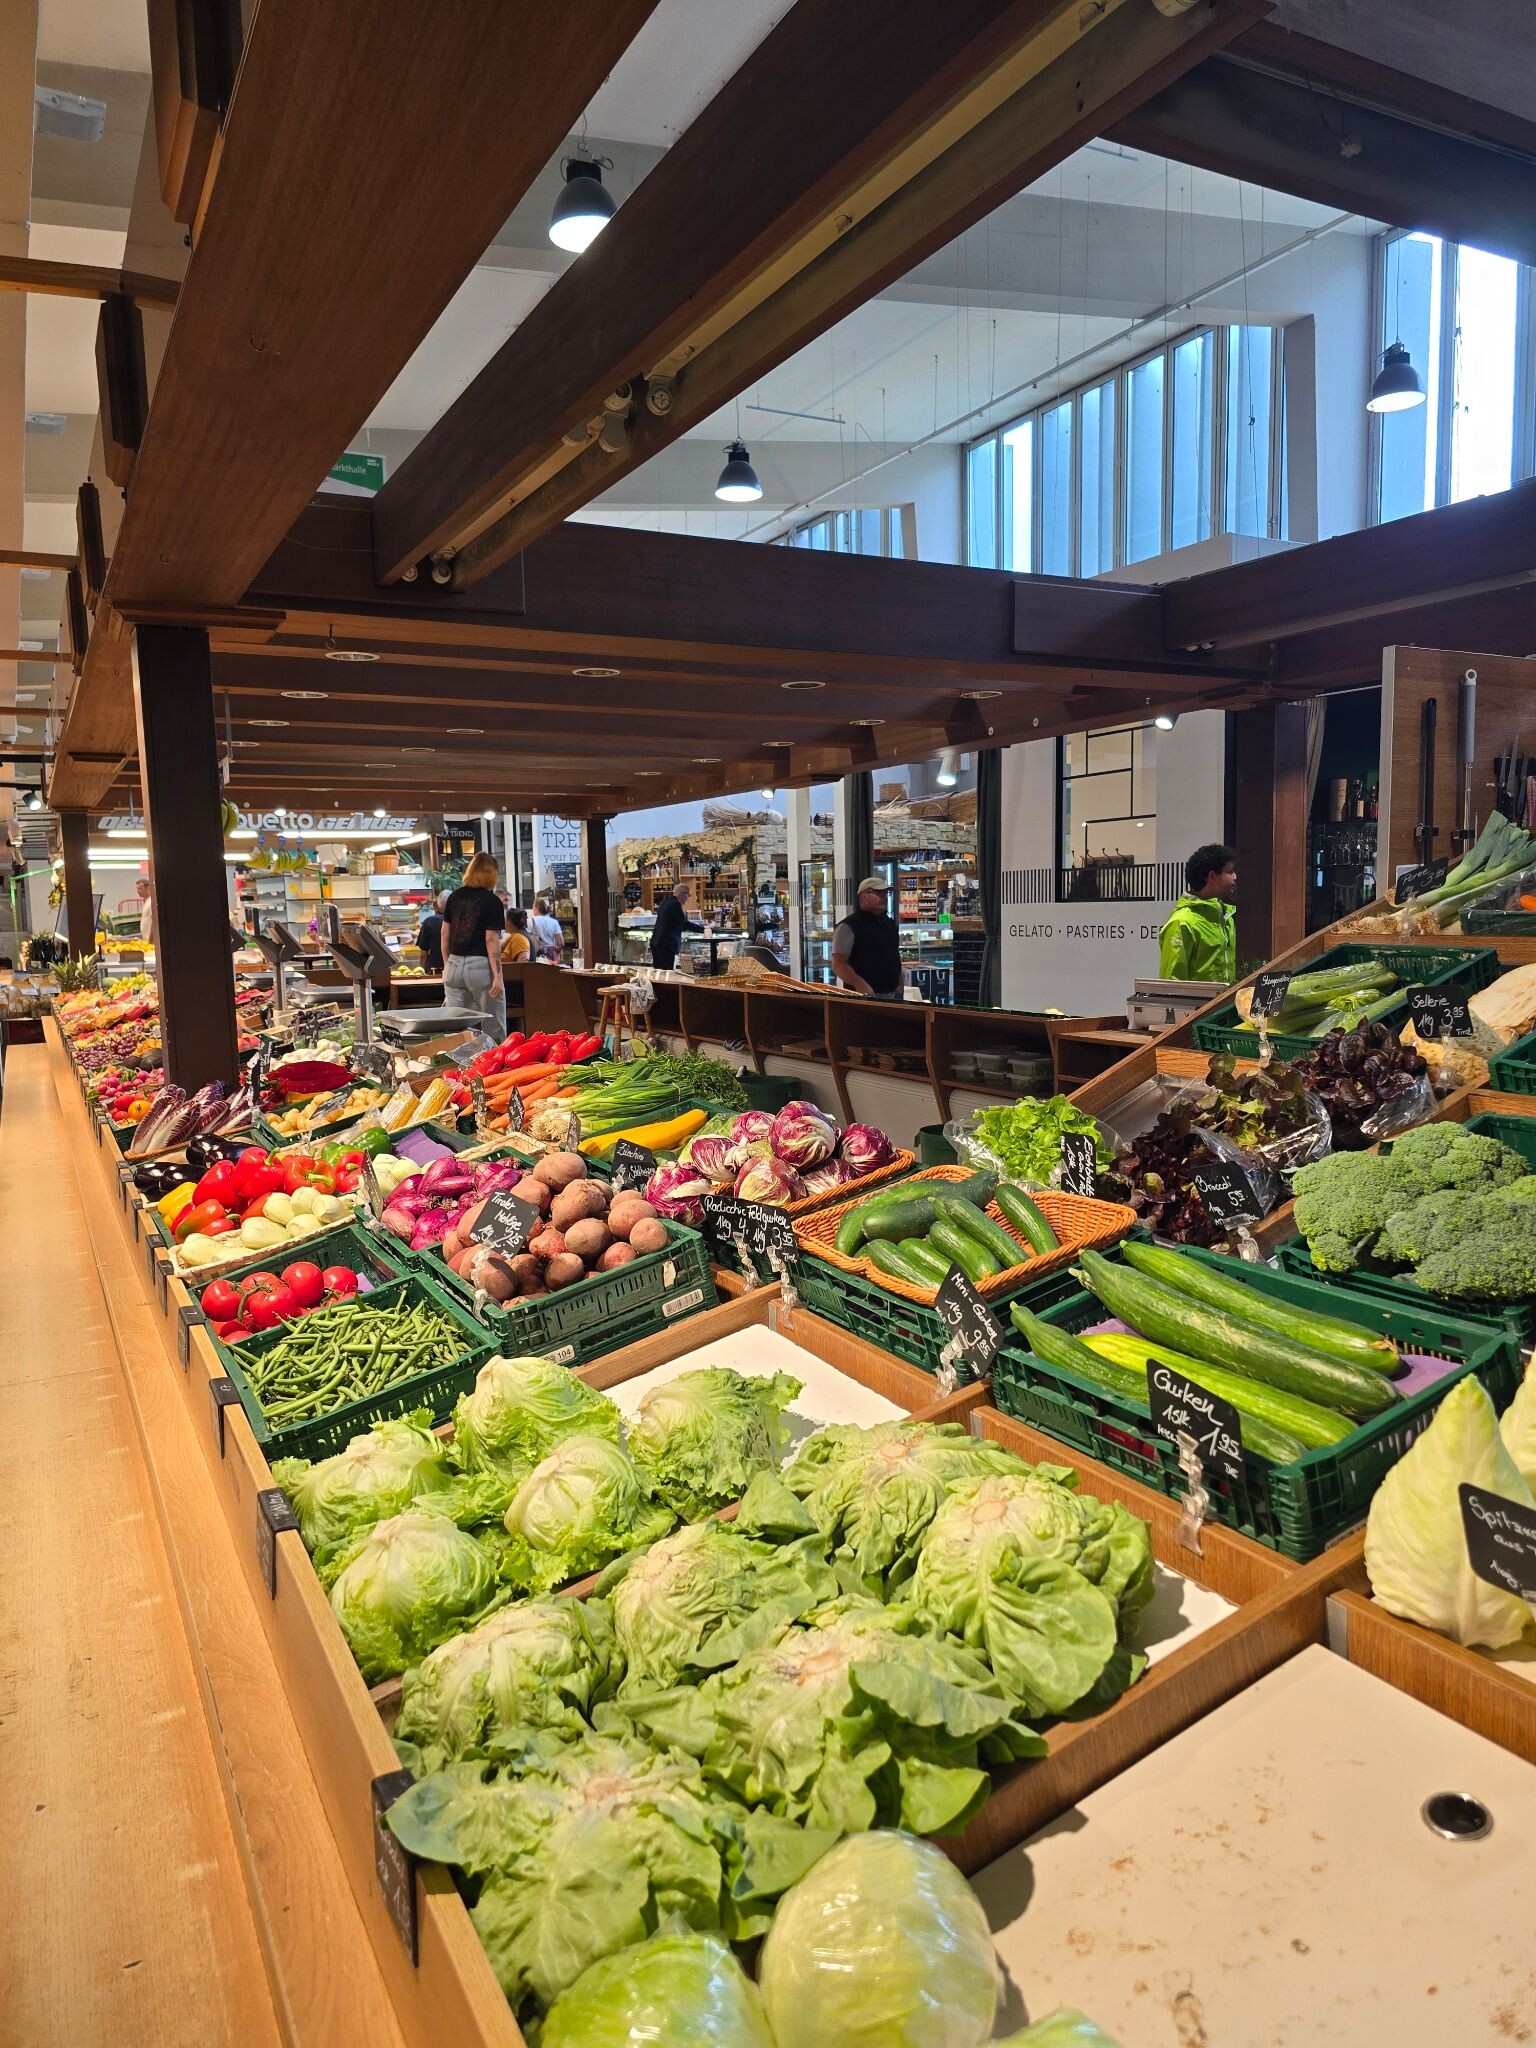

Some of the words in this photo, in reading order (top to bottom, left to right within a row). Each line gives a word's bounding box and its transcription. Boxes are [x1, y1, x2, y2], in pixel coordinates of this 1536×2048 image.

[332, 463, 367, 475] arkthalle
[542, 832, 581, 848] TRE
[1009, 924, 1053, 938] GELATO
[1066, 925, 1125, 939] PASTRIES
[1411, 993, 1450, 1009] Sellerie
[1418, 1013, 1434, 1037] 1kg
[716, 1215, 732, 1239] 1kg
[945, 1299, 963, 1325] 1kg
[557, 1348, 571, 1359] 104
[1153, 1369, 1224, 1427] Gurken
